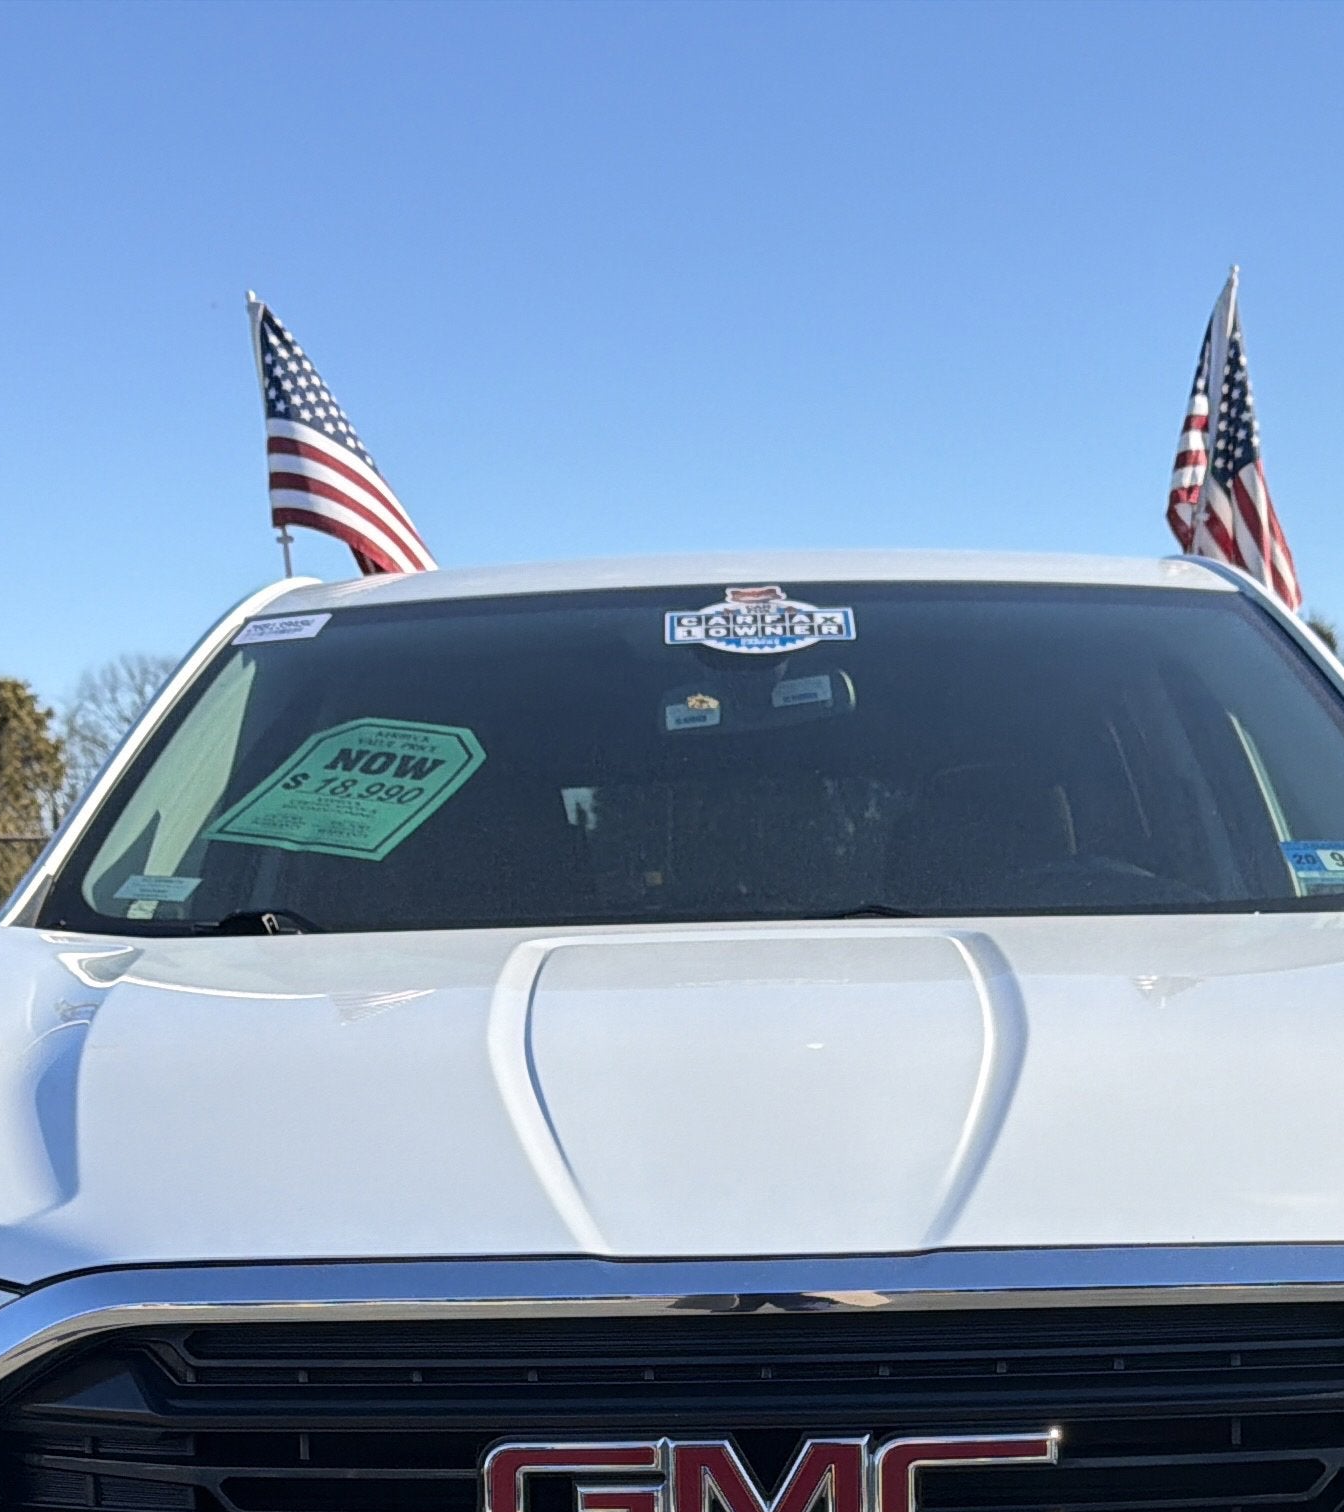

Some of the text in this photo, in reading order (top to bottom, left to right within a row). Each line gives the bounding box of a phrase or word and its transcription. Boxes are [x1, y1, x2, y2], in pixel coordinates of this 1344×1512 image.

[680, 614, 842, 627] CARFAX
[708, 625, 839, 637] OWNER
[323, 748, 447, 781] NOW
